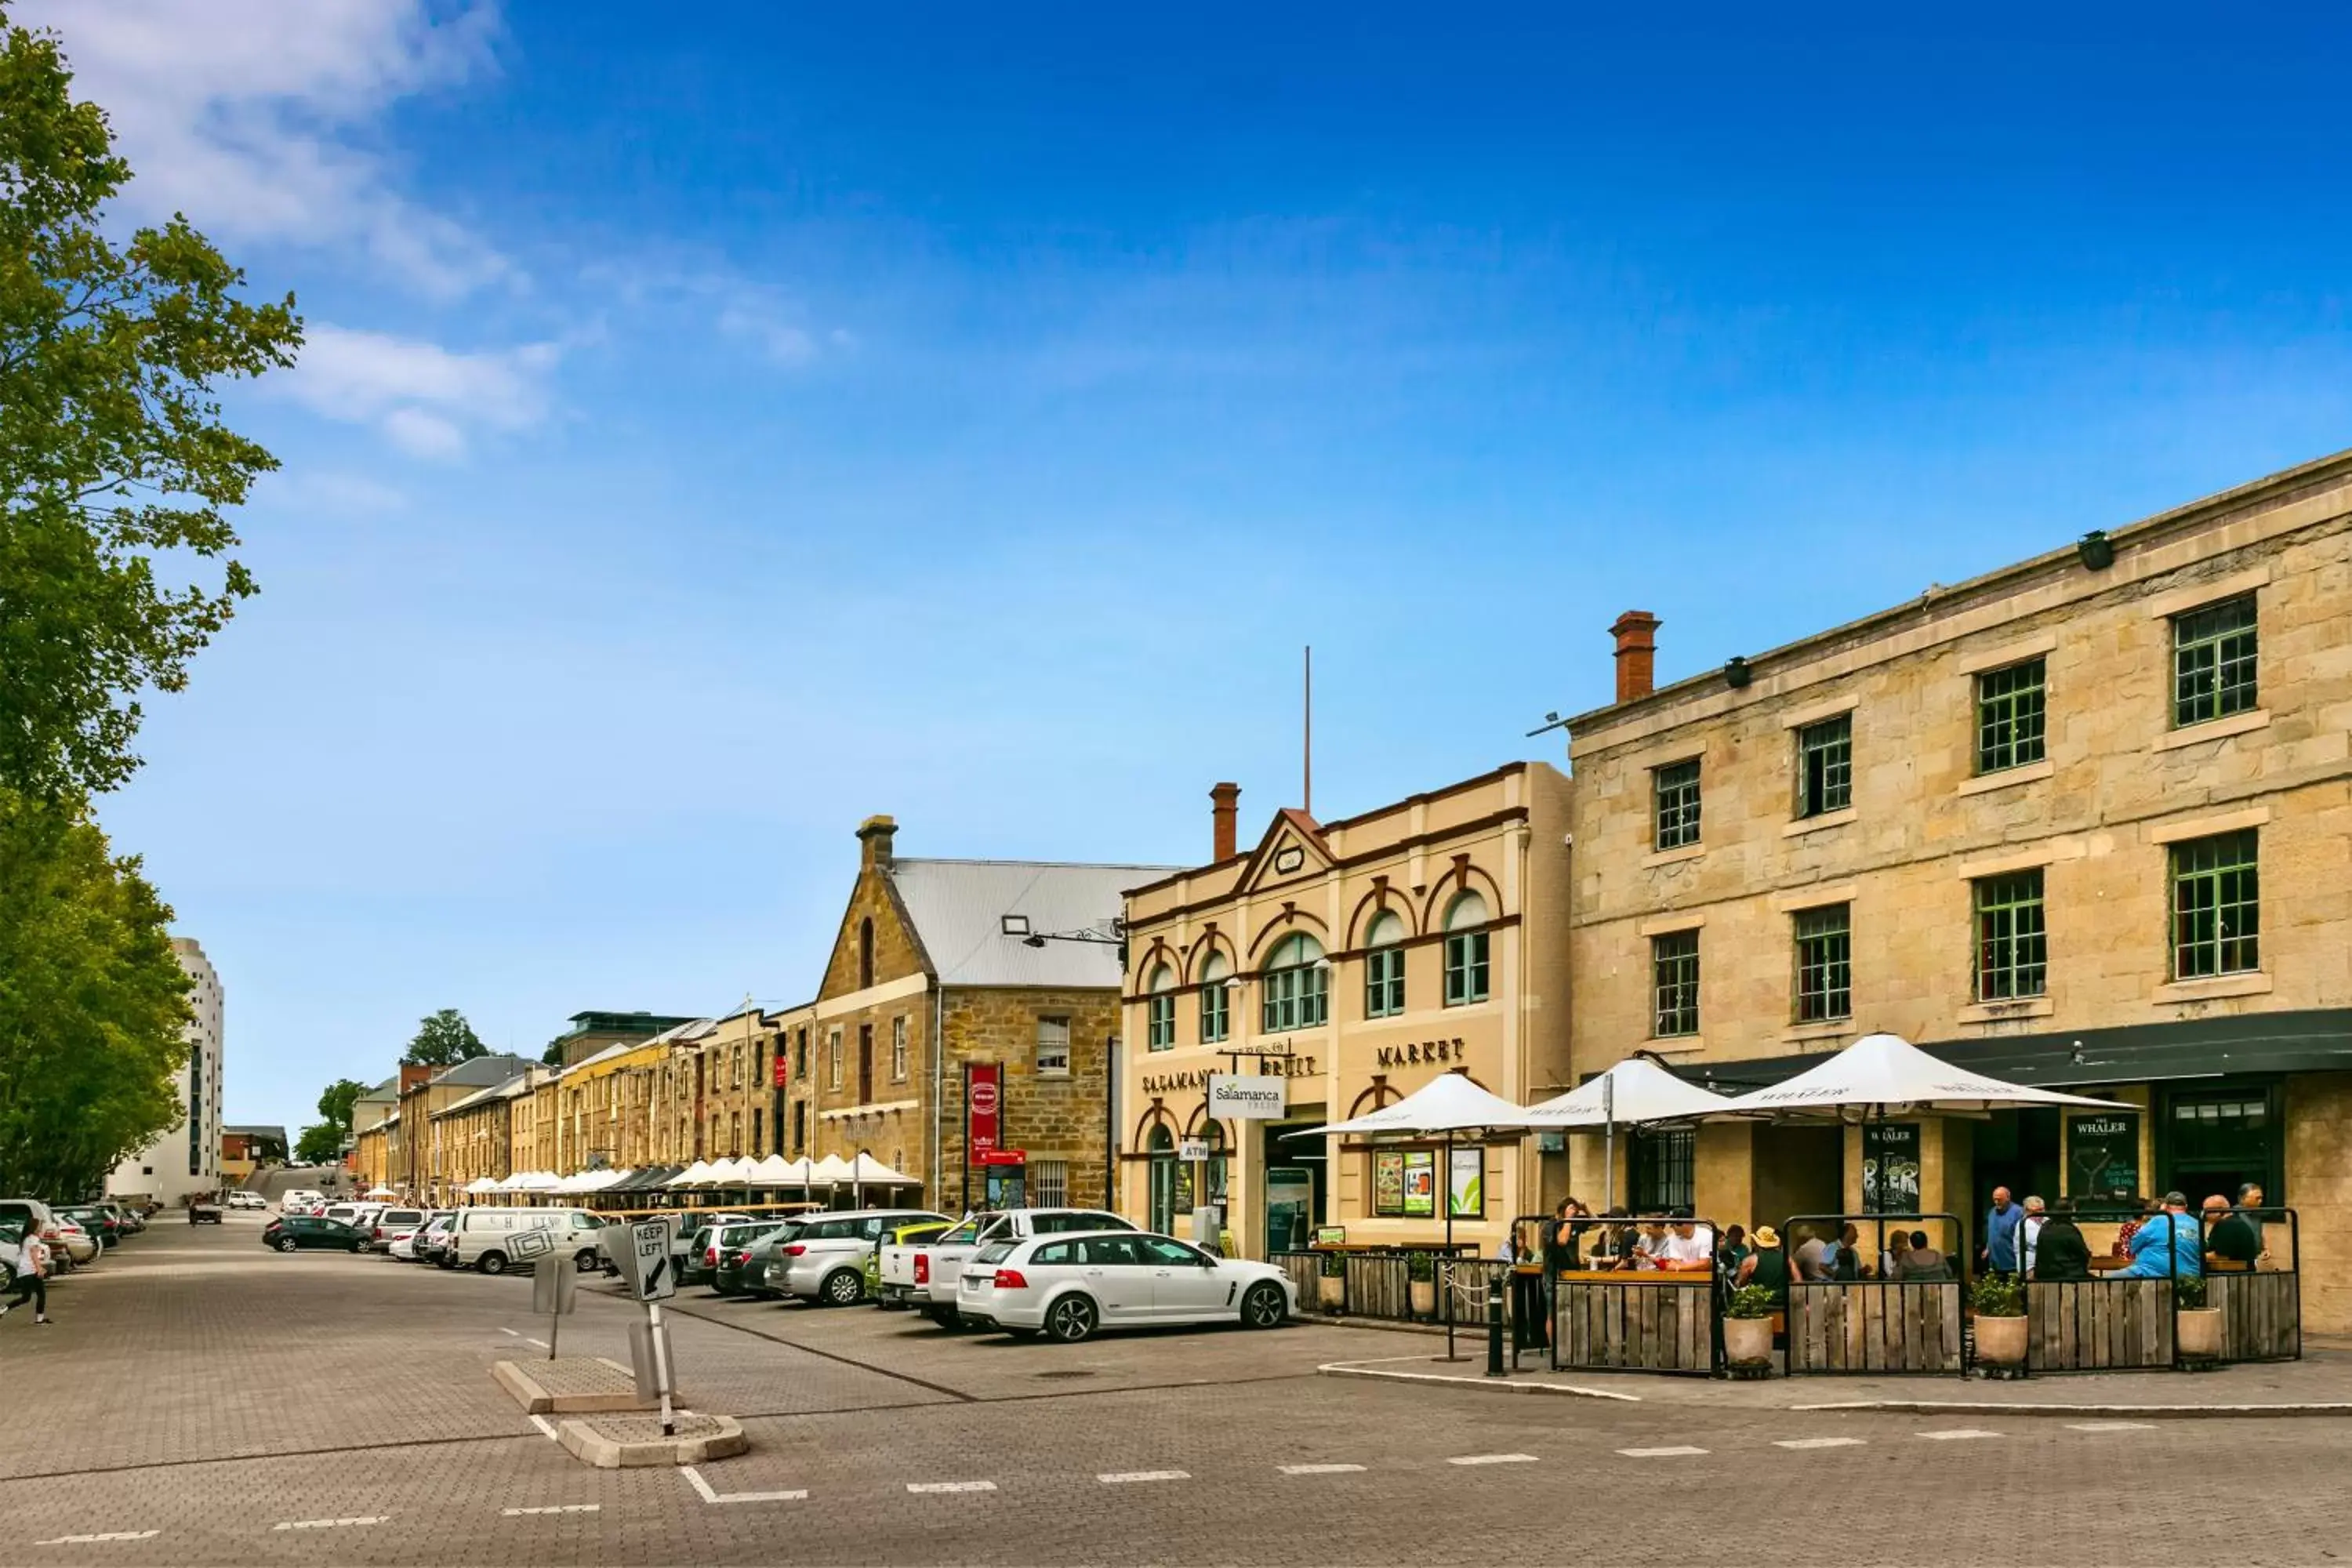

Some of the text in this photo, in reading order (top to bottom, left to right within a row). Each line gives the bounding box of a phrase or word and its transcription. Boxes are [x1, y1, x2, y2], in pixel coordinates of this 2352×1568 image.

[1377, 1037, 1465, 1067] MARKET
[1216, 1087, 1279, 1101] Salamanca
[2077, 1122, 2127, 1134] WHALER
[1185, 1146, 1207, 1156] ATM
[636, 1225, 663, 1240] KEEP
[639, 1242, 663, 1257] LEFT
